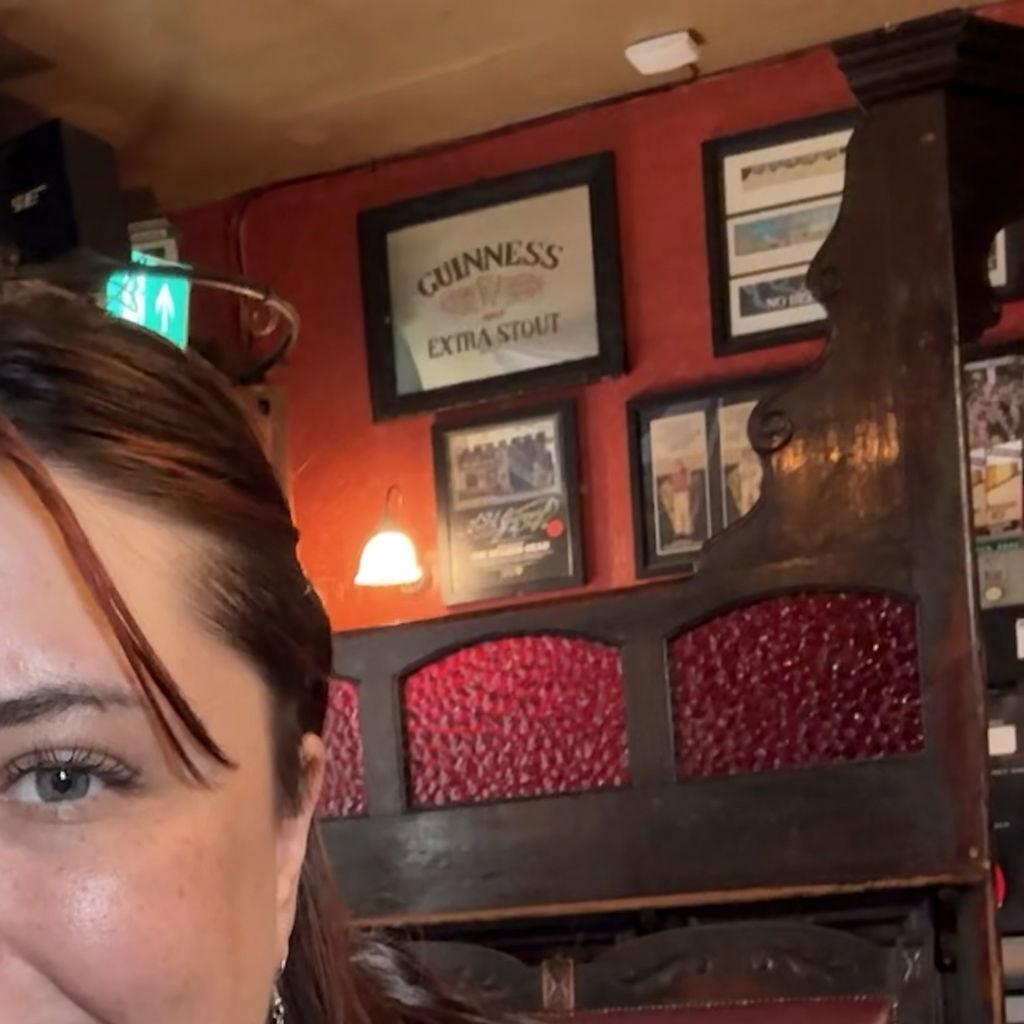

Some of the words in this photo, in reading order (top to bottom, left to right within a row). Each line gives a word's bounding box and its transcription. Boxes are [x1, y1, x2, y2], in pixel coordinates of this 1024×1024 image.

[416, 240, 560, 298] GUINNESS
[427, 327, 493, 359] EXTRA
[497, 312, 560, 344] STOUT
